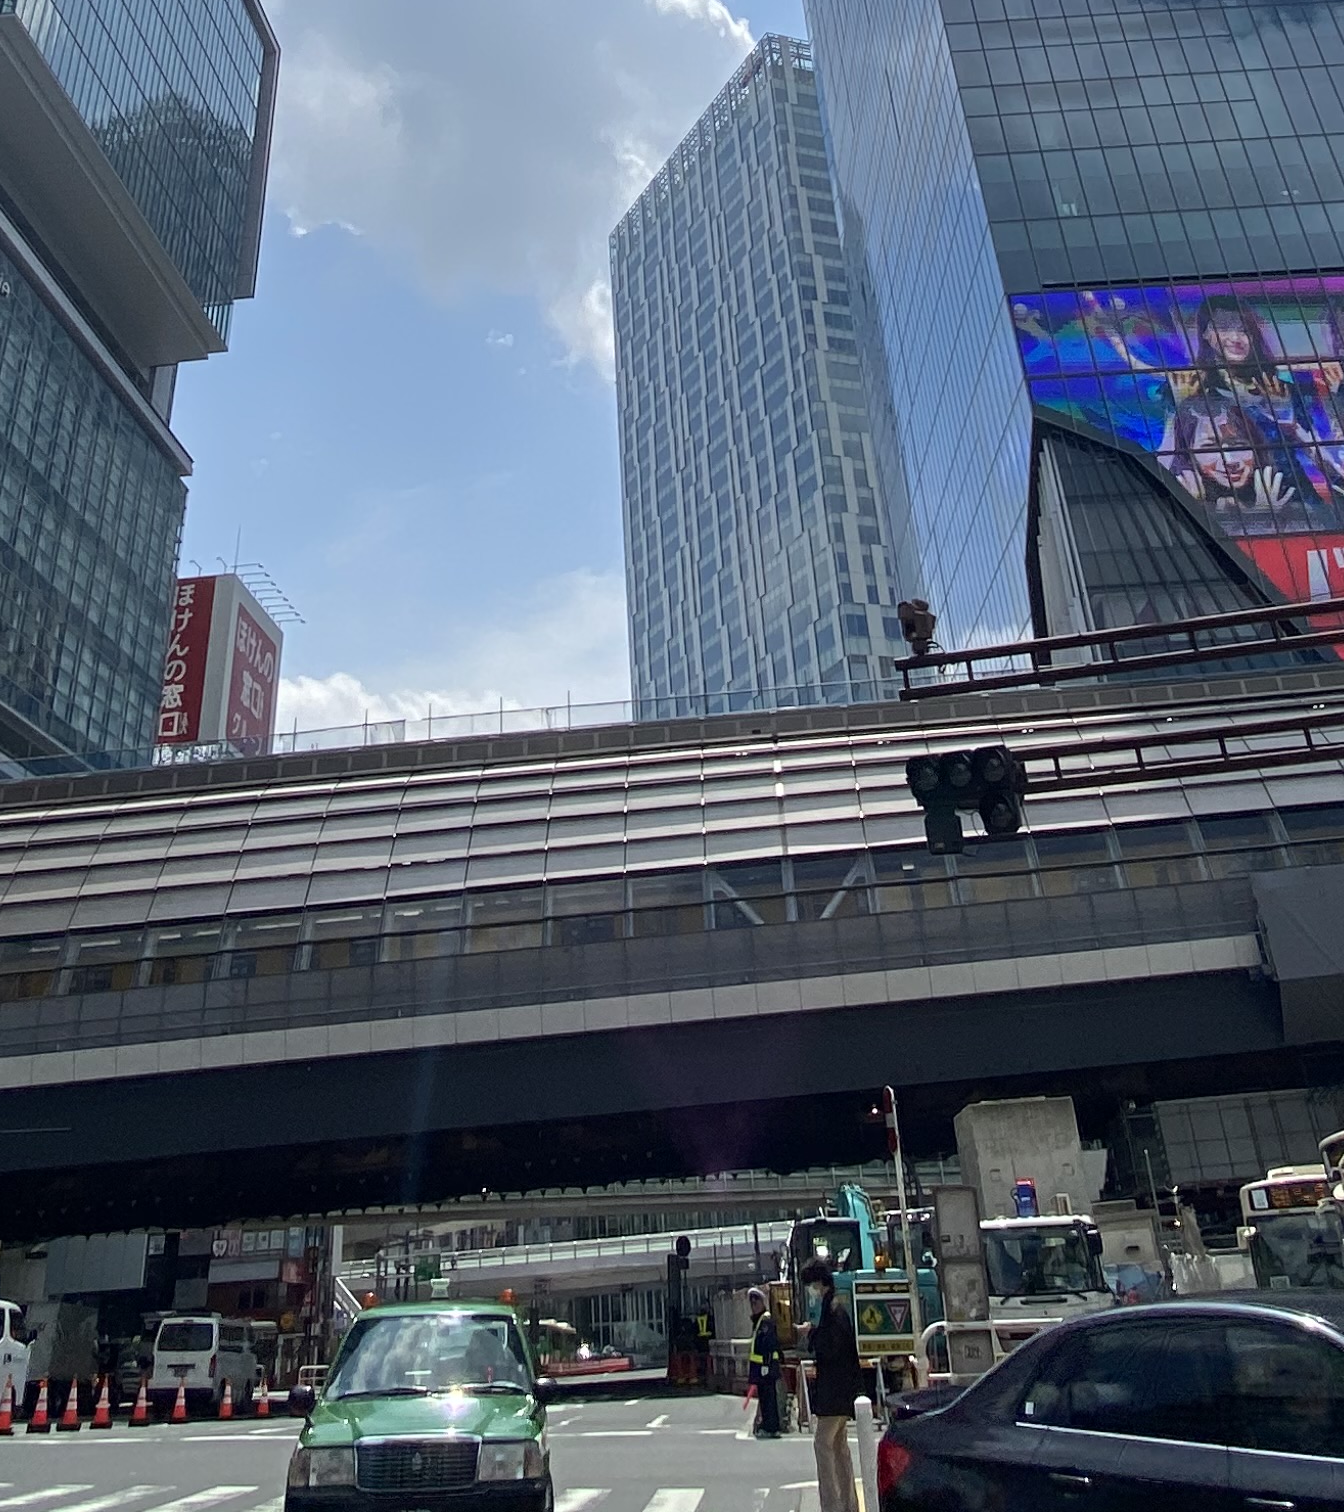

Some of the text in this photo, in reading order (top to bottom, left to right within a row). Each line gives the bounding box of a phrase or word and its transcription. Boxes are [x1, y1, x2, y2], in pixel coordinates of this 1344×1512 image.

[157, 583, 196, 737] ほけんの窓口
